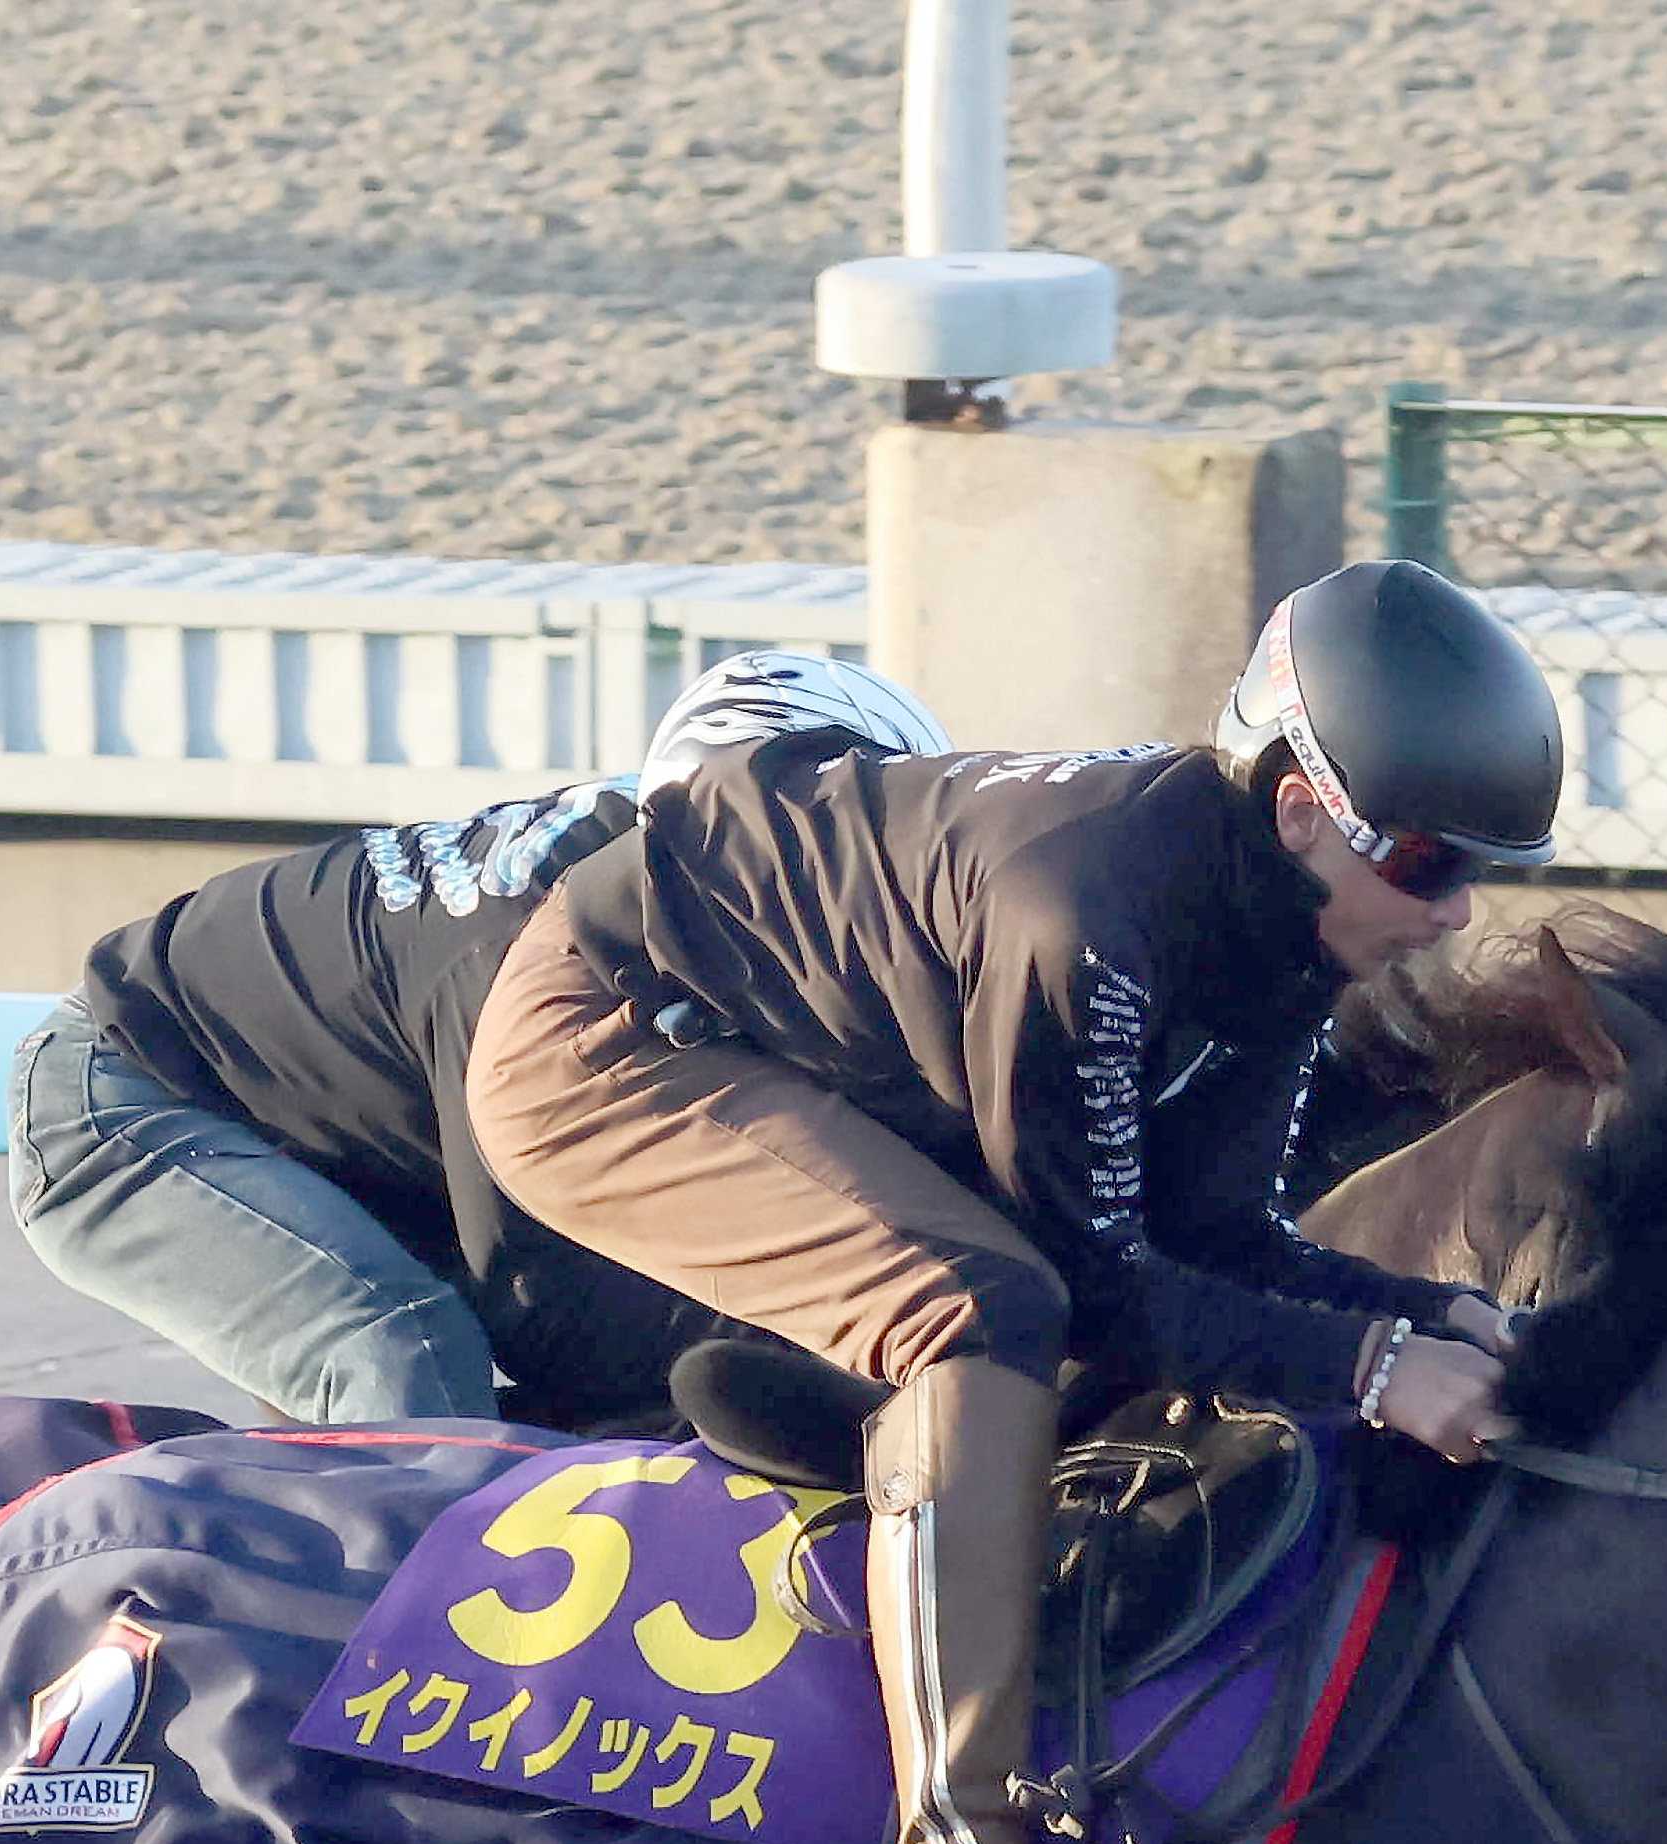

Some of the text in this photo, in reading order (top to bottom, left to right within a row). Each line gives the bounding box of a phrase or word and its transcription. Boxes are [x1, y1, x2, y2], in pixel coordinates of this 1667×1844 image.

[447, 1456, 854, 1694] 53
[44, 1779, 139, 1804] STABLE
[344, 1668, 775, 1830] イクイノックス
